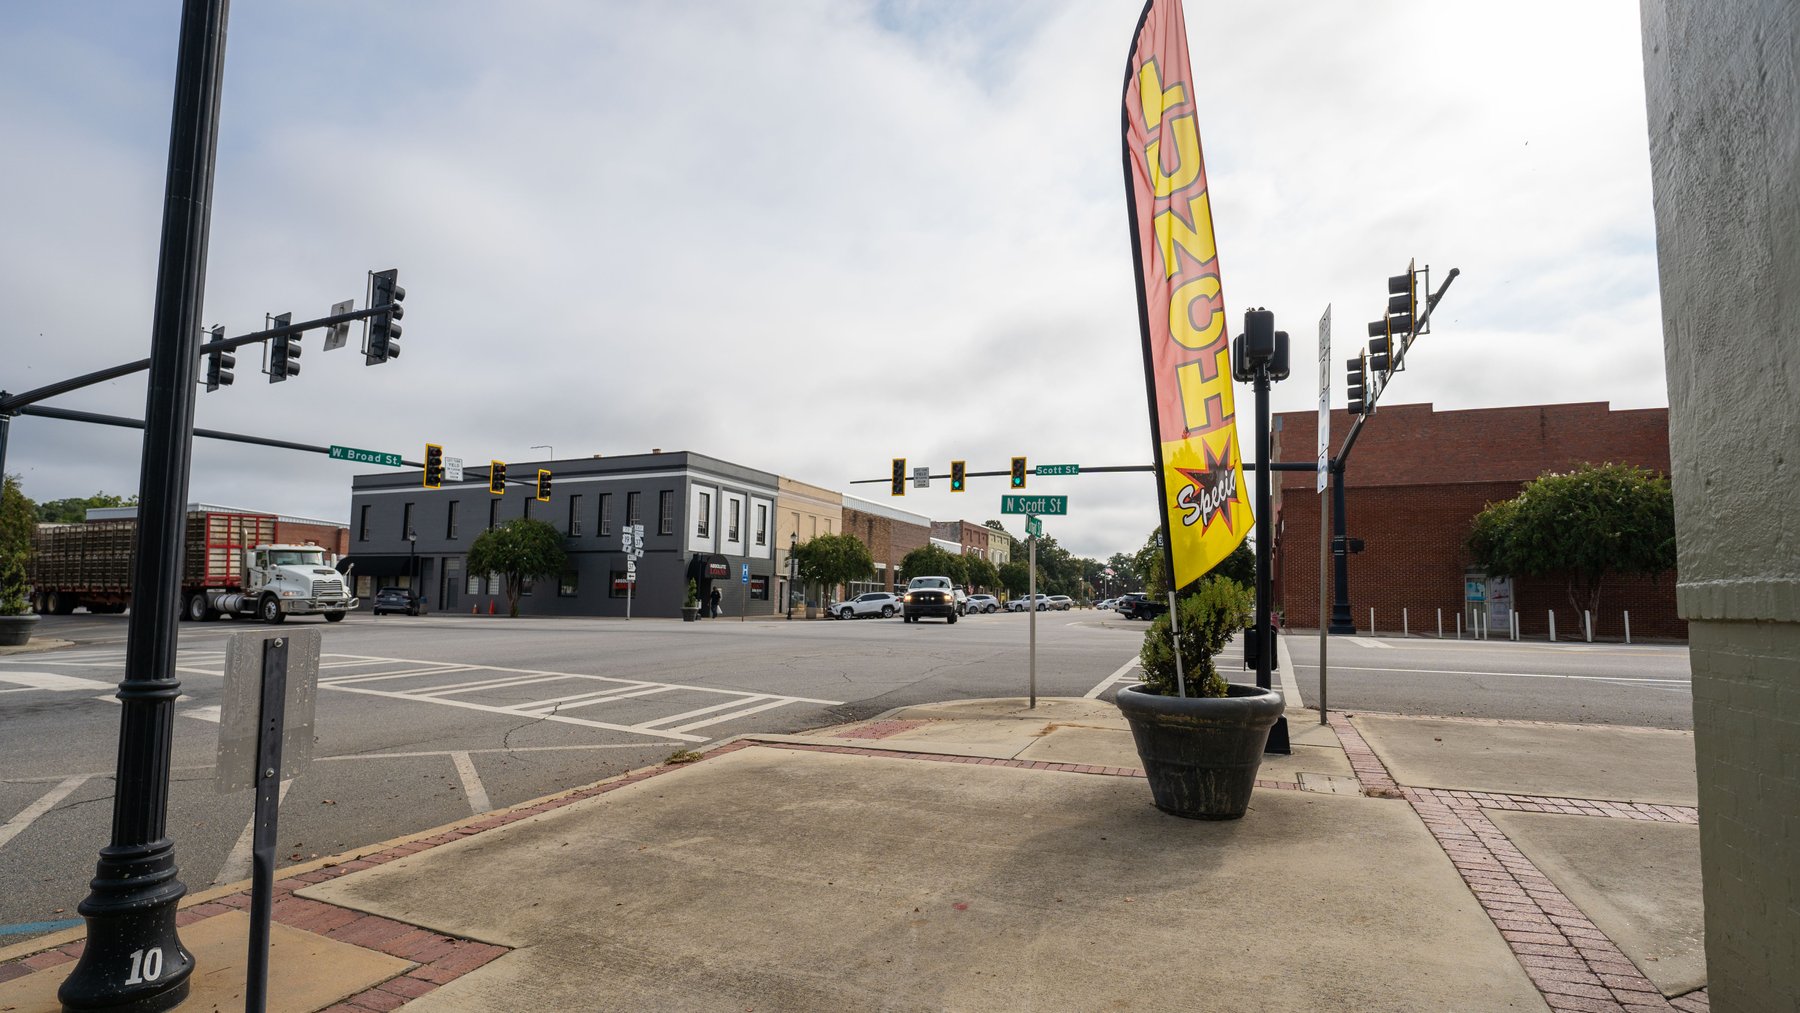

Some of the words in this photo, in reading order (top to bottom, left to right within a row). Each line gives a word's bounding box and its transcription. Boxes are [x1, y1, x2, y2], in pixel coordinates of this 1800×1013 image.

[1137, 54, 1236, 434] LUNCH
[332, 447, 344, 458] W.
[347, 449, 381, 462] Broad
[385, 455, 400, 466] St.
[1036, 466, 1062, 475] Scott
[1065, 466, 1078, 474] St.
[1006, 497, 1015, 512] N
[1019, 497, 1046, 513] Scott
[1049, 497, 1061, 513] St
[124, 946, 163, 986] 10
